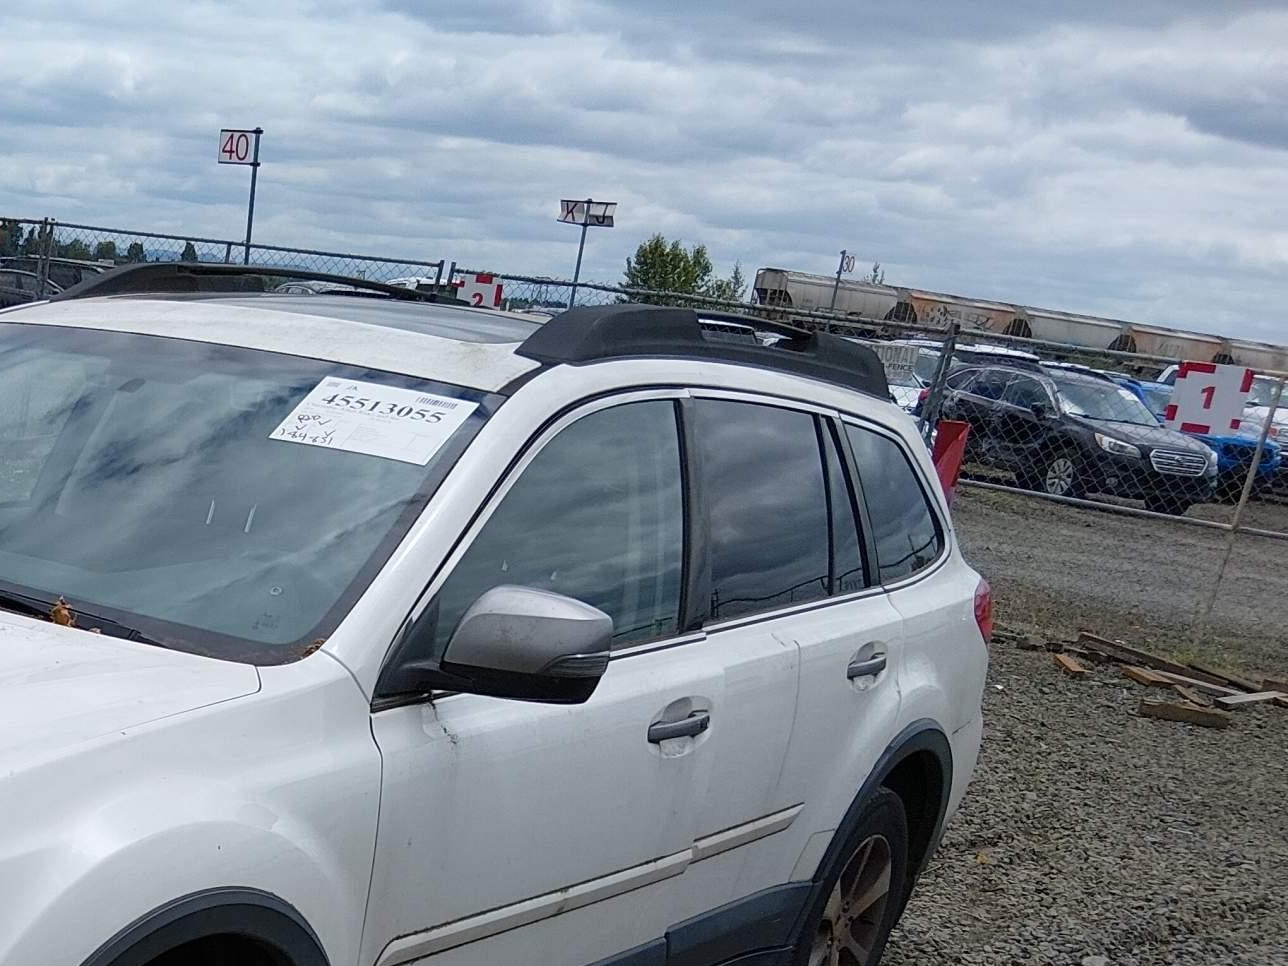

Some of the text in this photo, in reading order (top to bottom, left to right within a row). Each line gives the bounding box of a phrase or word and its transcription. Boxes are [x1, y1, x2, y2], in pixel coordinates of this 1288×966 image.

[222, 133, 249, 161] 40
[563, 202, 609, 224] K J
[472, 292, 484, 307] 2
[322, 393, 447, 424] 45513055
[1201, 387, 1216, 410] 1
